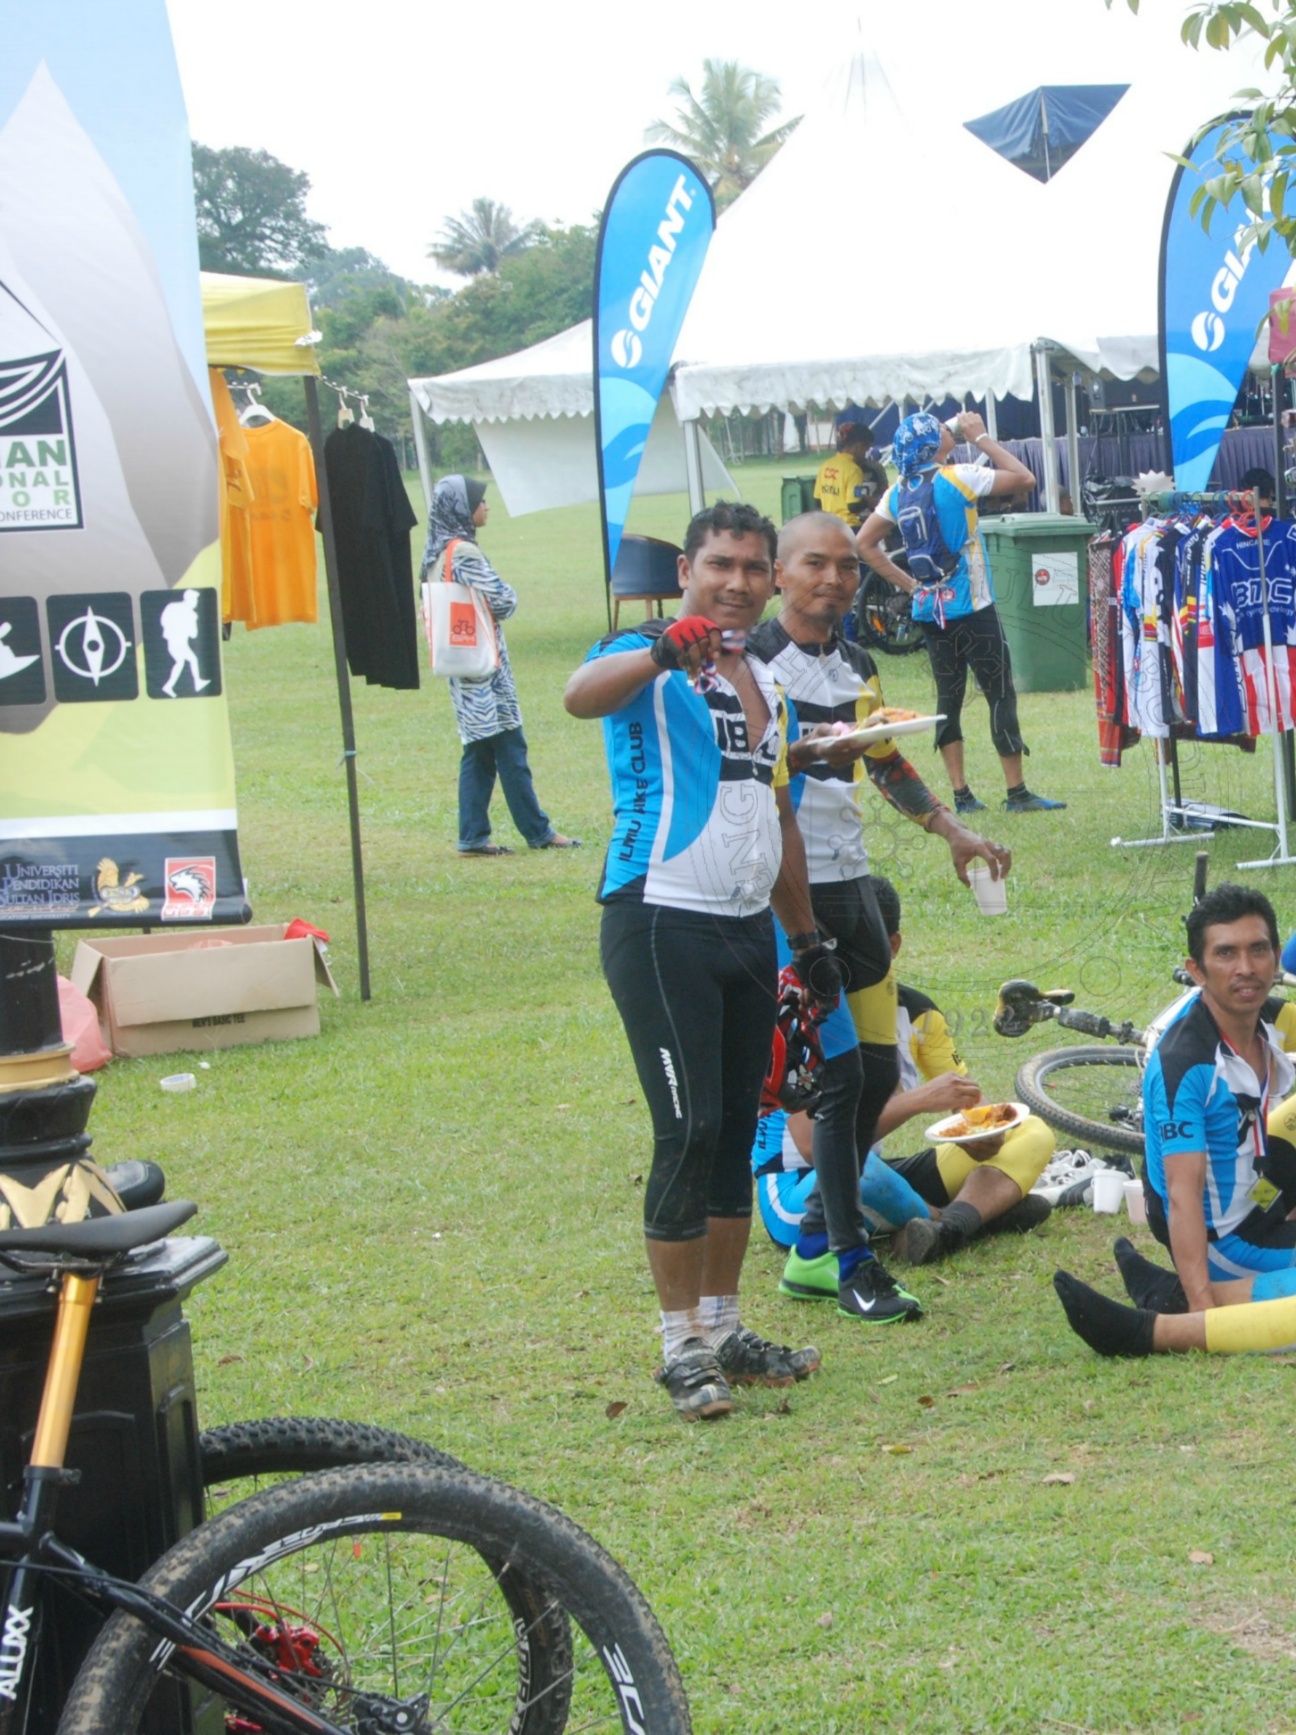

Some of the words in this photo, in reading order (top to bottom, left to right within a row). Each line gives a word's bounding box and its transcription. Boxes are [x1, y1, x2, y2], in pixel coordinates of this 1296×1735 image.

[629, 173, 693, 332] GIANT
[629, 721, 646, 774] CLUB
[1160, 1121, 1195, 1141] IBC
[0, 1603, 34, 1700] ALUXX
